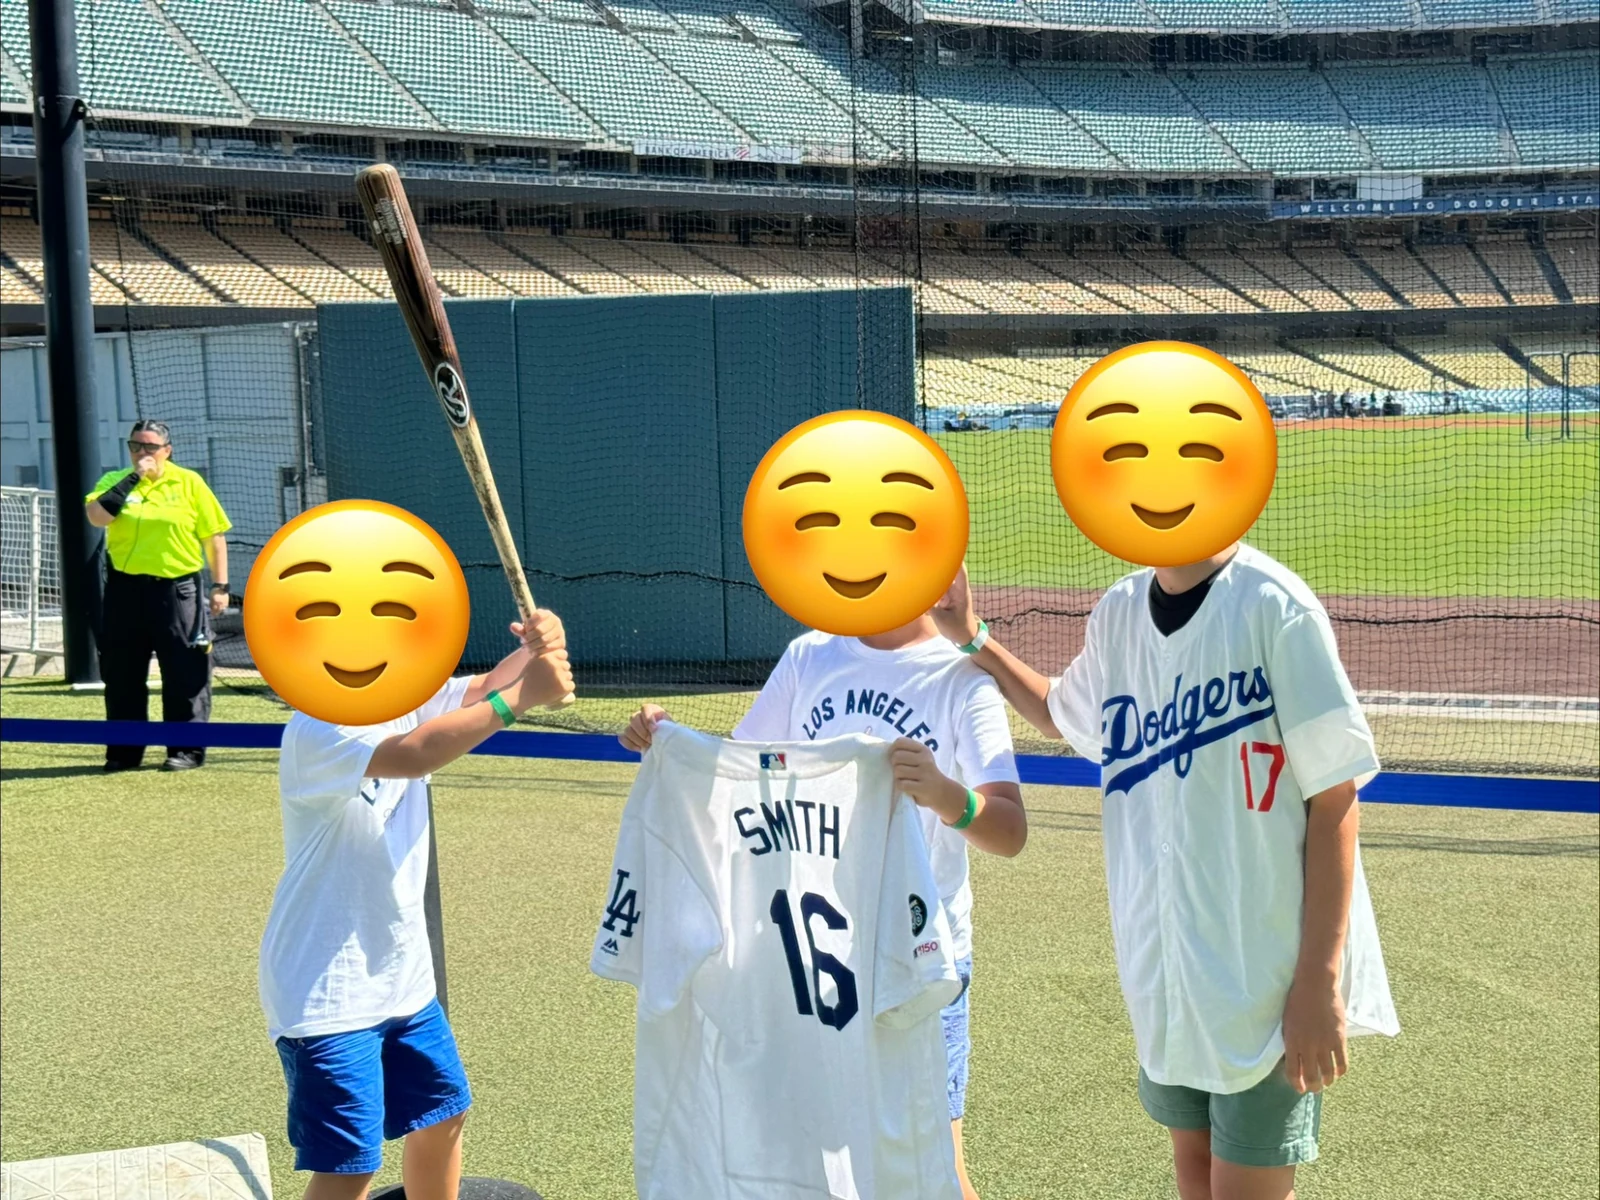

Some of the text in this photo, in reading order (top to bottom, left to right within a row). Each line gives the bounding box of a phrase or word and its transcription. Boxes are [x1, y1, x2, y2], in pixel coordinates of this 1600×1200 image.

[645, 145, 730, 159] BANK OF AMERICA
[1300, 195, 1594, 213] WELCOME TO DODGER STA
[802, 696, 835, 741] LOS
[1101, 665, 1272, 780] Dodgers
[1240, 741, 1286, 813] 17
[734, 799, 840, 860] SMITH
[602, 868, 641, 938] LA
[769, 888, 859, 1032] 16
